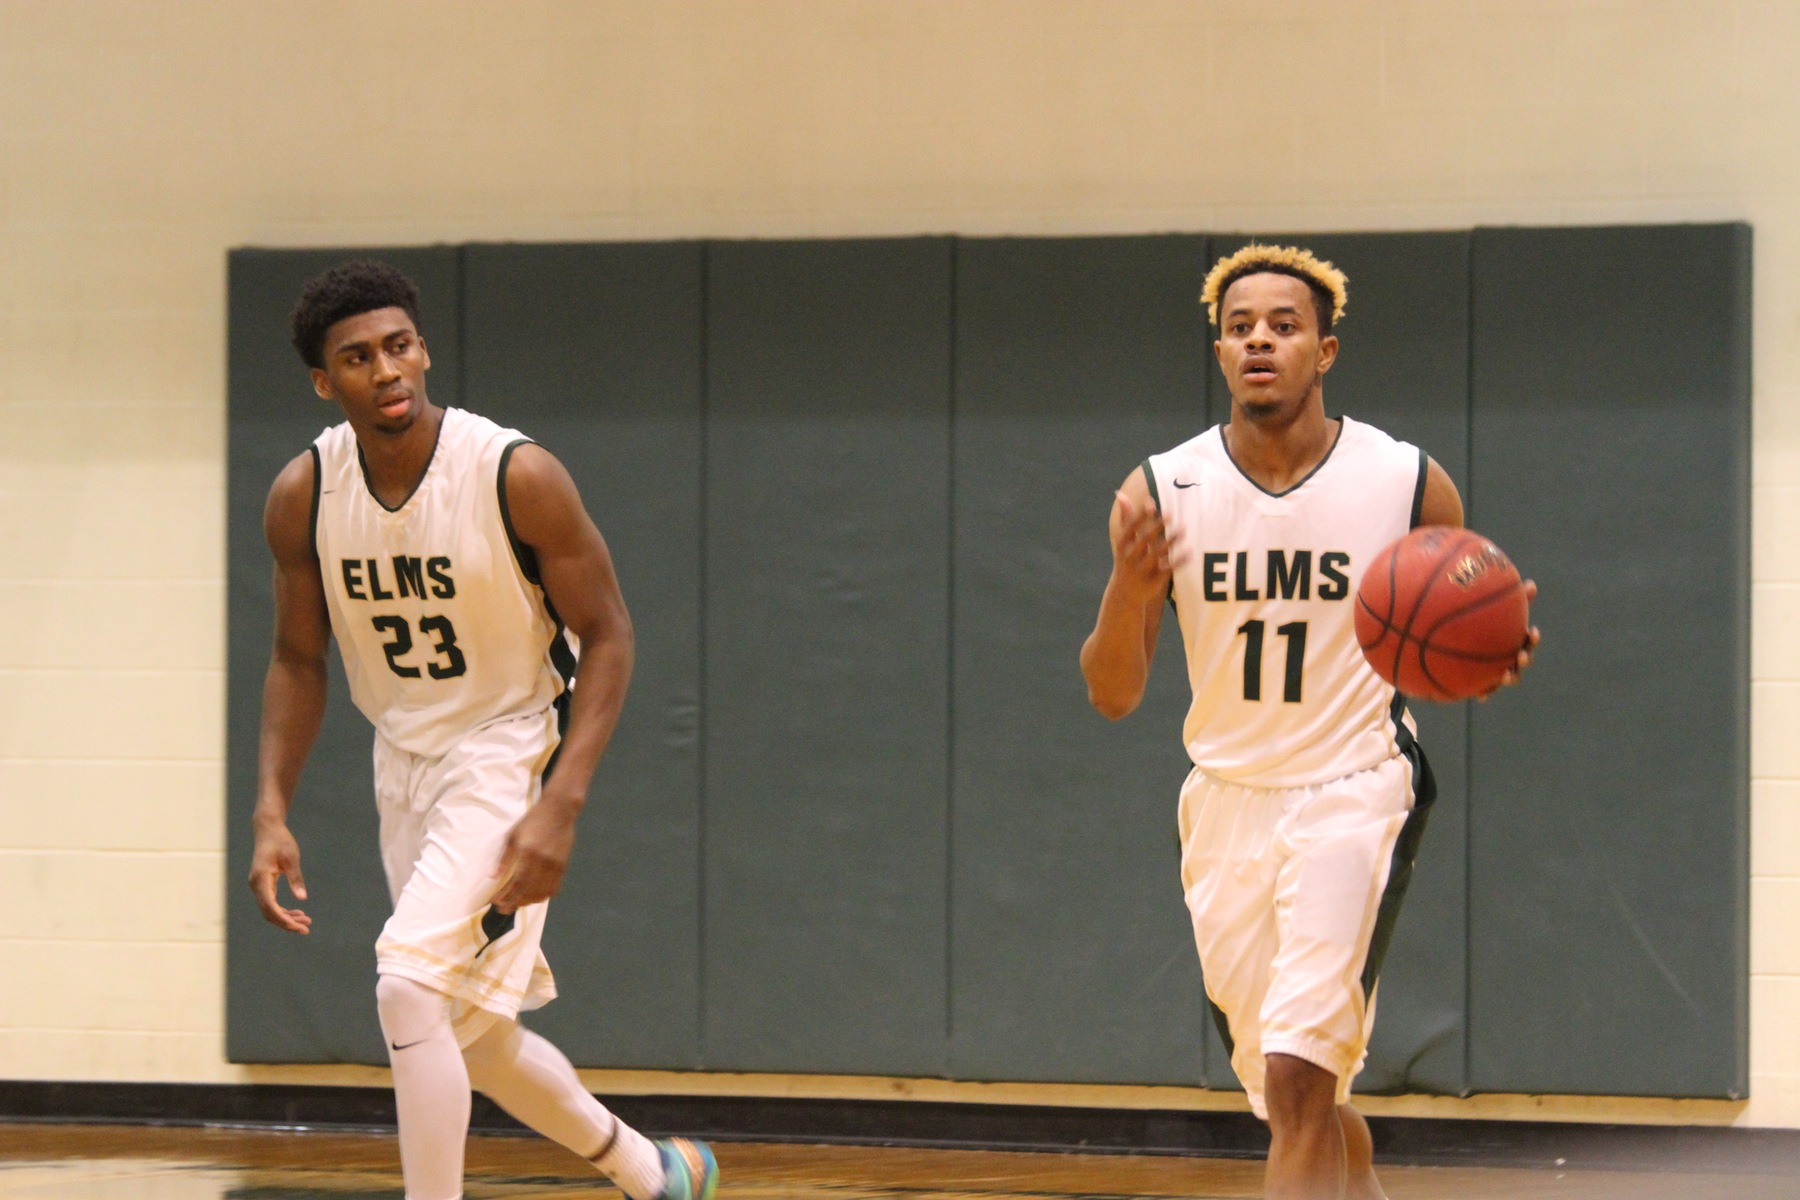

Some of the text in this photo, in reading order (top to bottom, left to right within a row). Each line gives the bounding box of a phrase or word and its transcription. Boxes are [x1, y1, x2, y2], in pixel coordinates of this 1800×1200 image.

[341, 555, 456, 601] ELMS
[1203, 550, 1350, 601] ELMS
[372, 615, 467, 680] 23
[1237, 620, 1307, 703] 11
